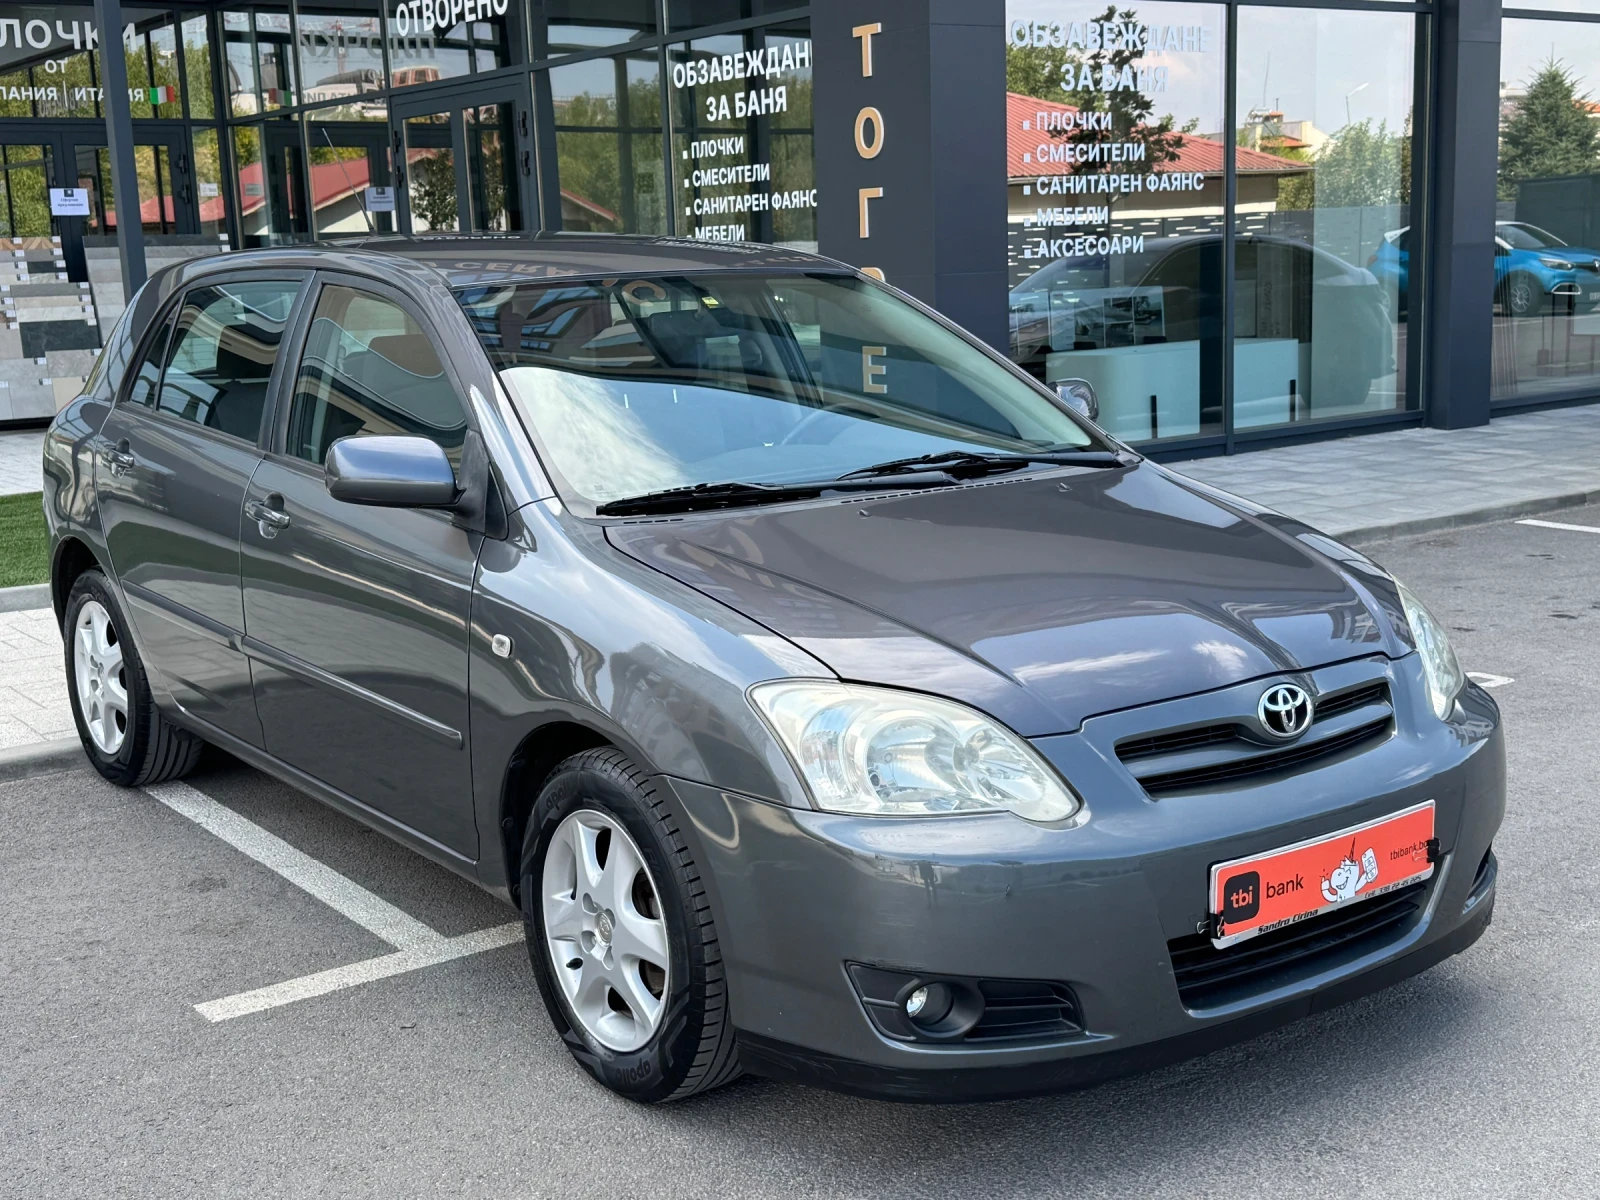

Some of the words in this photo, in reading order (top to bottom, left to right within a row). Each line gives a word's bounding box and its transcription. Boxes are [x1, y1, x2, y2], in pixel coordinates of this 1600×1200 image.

[1010, 20, 1213, 56] ОБЗАВЕЖДАНЕ
[44, 59, 68, 73] ОТ
[673, 39, 812, 88] ОБЗАВЕЖДАН
[1060, 63, 1094, 91] ЗА
[1102, 64, 1169, 92] БАНЯ
[706, 96, 731, 122] ЗА
[735, 86, 787, 118] БАНЯ
[1036, 111, 1112, 131] ПЛОЧКИ
[691, 136, 744, 159] ПЛОЧКИ
[1036, 143, 1146, 163] СМЕСИТЕЛИ
[692, 163, 771, 188] СМЕСИТЕЛИ
[1036, 175, 1142, 196] САНИТАРЕН
[1146, 173, 1205, 192] ФАЯНС
[694, 194, 769, 216] САНИТАРЕН
[771, 189, 818, 211] ФАЯНС
[1037, 206, 1109, 227] МЕБЕЛИ
[695, 224, 746, 241] МЕБЕЛИ
[1037, 236, 1144, 258] АКСЕСОАРИ
[1231, 885, 1253, 909] tbi
[1266, 873, 1304, 899] bank
[1257, 918, 1291, 935] Sandro
[1292, 908, 1319, 923] Cirina
